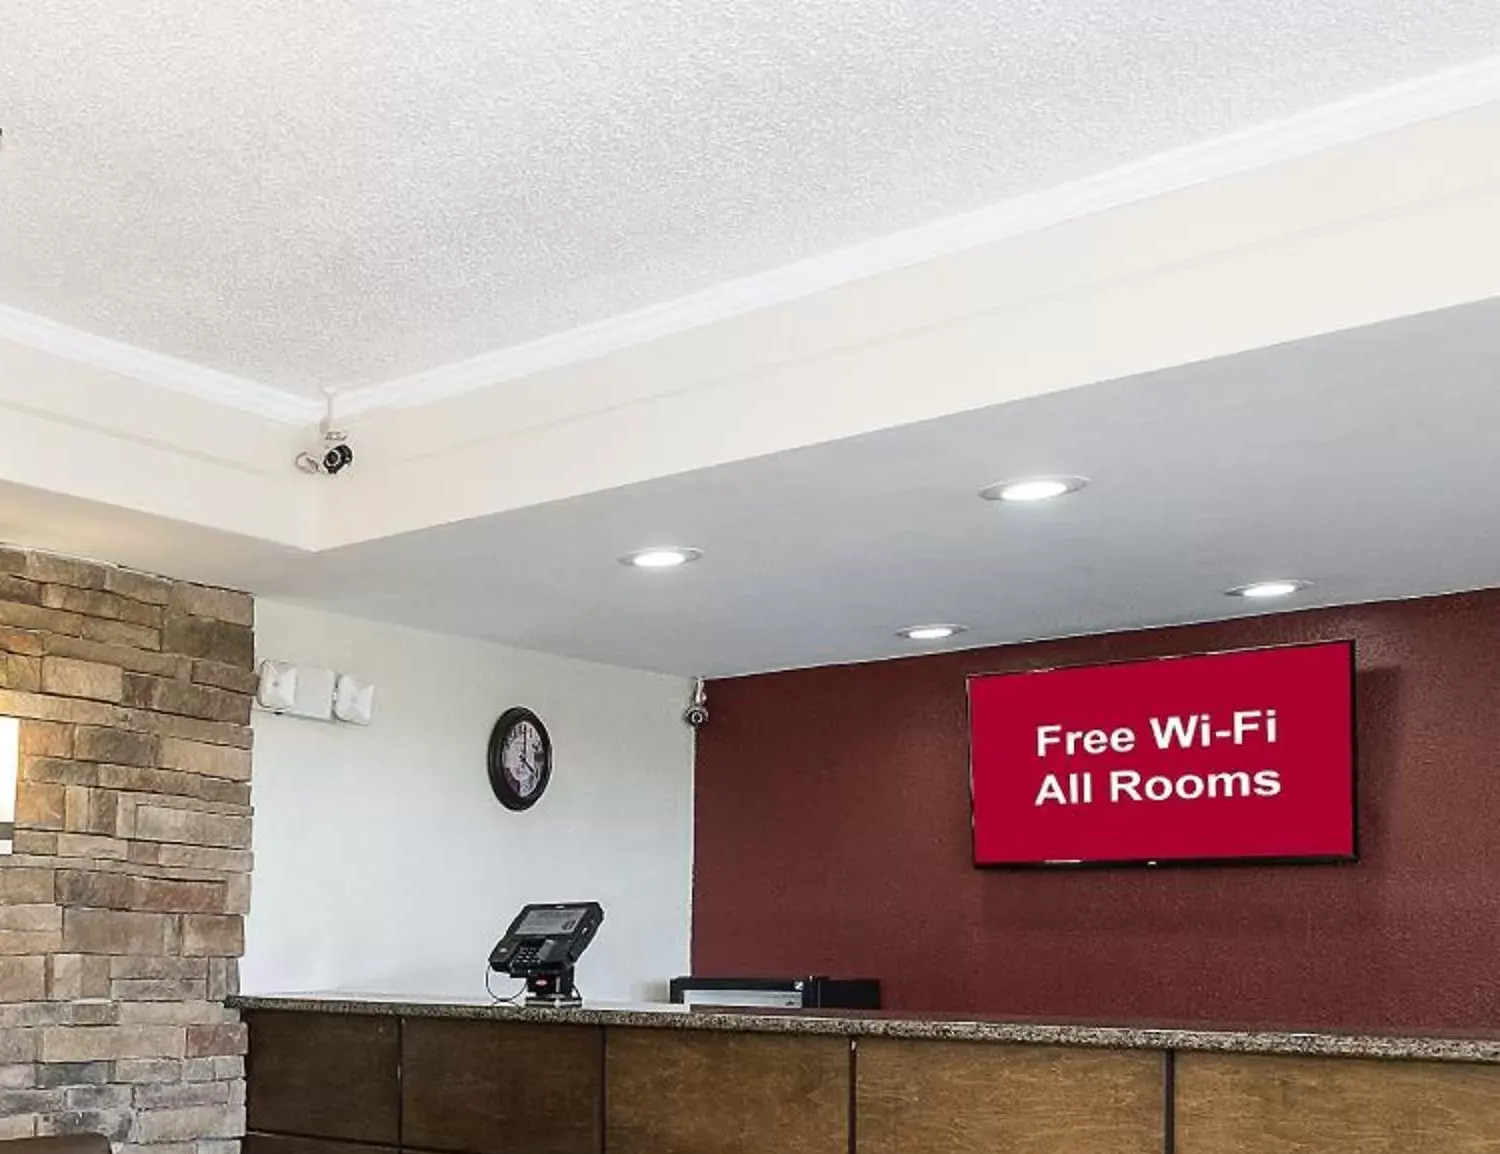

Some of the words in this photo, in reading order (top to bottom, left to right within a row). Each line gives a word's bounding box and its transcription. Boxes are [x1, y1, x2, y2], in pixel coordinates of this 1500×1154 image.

[1035, 724, 1137, 757] Free
[1149, 709, 1278, 750] Wi-Fi
[1034, 772, 1093, 806] All
[1109, 769, 1282, 803] Rooms
